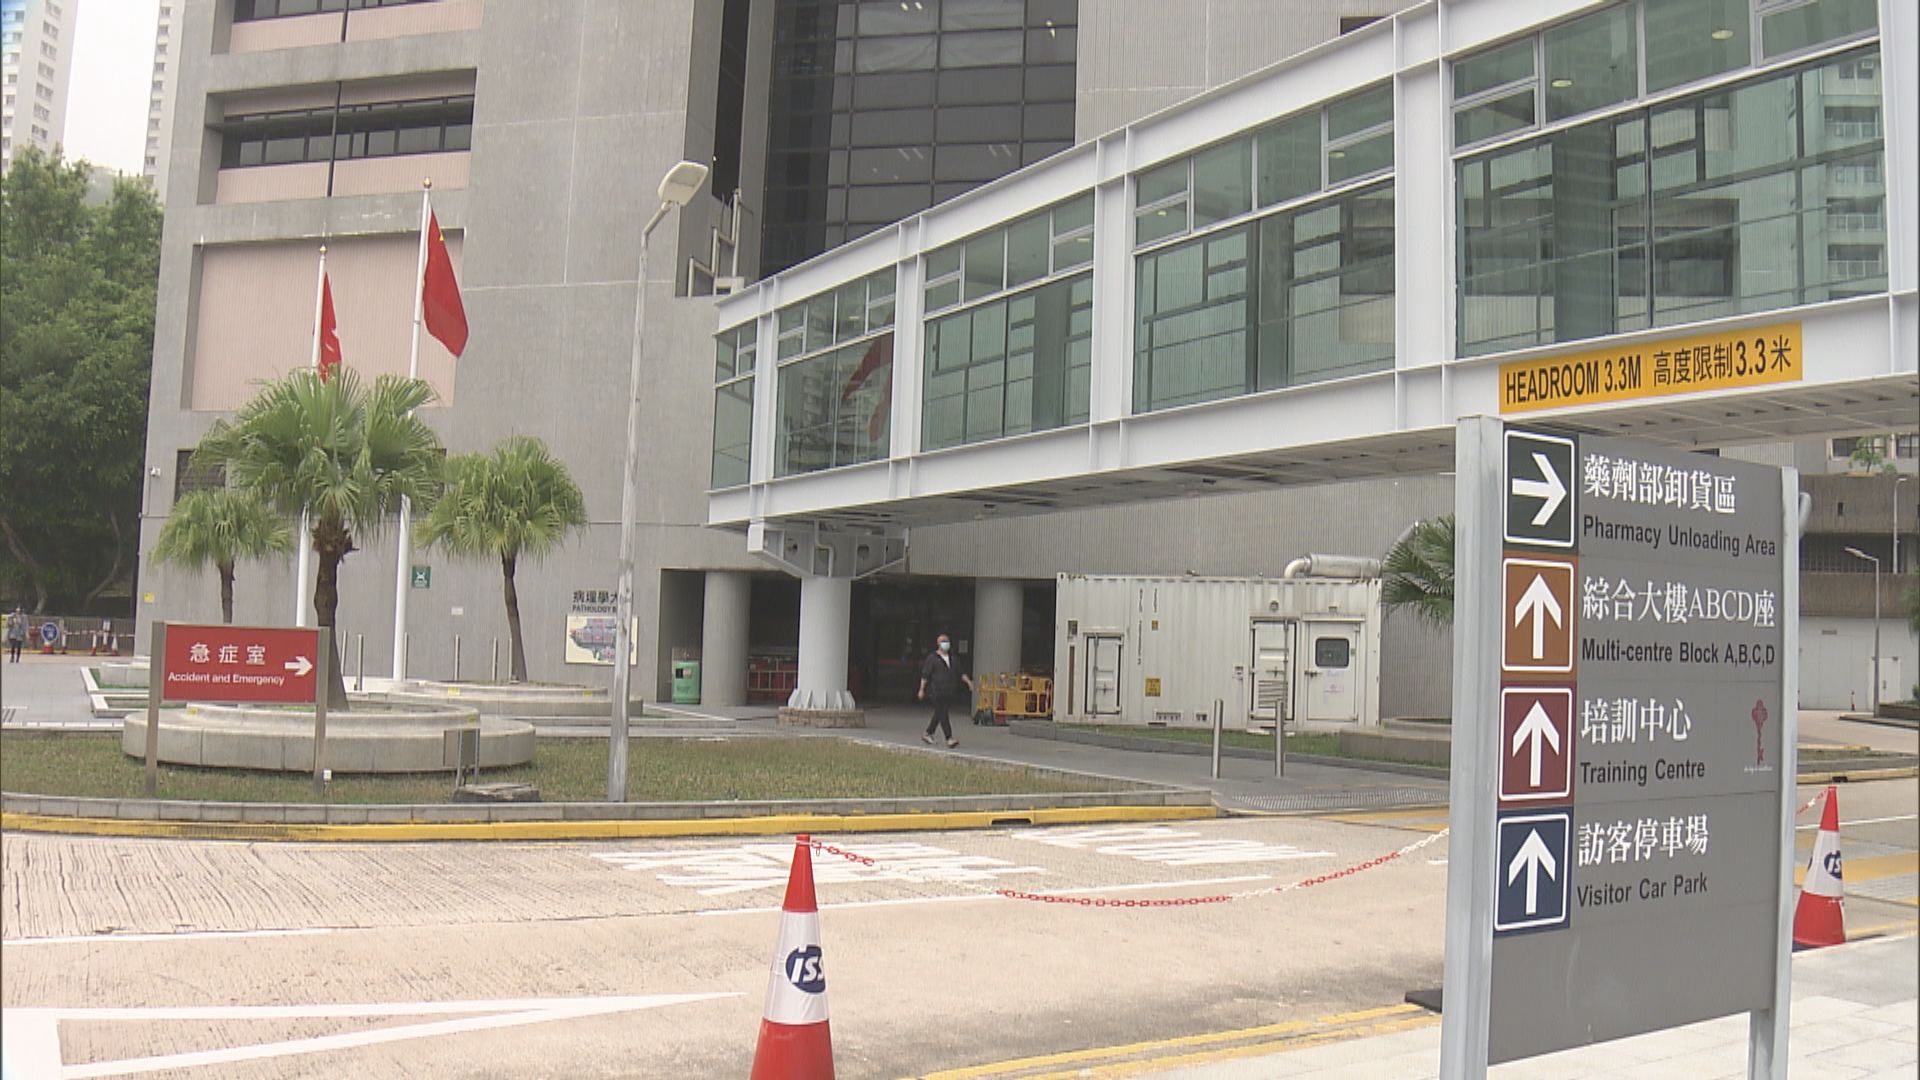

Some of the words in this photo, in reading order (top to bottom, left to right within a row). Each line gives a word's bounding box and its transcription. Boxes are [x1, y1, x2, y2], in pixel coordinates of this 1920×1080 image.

[1506, 360, 1599, 404] HEADROOM
[1605, 354, 1641, 392] 3.3M
[1653, 335, 1792, 387] 高度限制3.3米
[1583, 454, 1737, 514] 藥劑部卸貨區
[1583, 514, 1661, 549] Pharmacy
[1669, 525, 1740, 557] Unloading
[1745, 534, 1776, 556] Area
[1582, 576, 1776, 628] 綜合大樓ABCD座
[190, 642, 266, 665] 急症室
[1582, 638, 1673, 663] Multi-centre
[1680, 641, 1719, 663] Block
[1724, 643, 1775, 668] A,B,C,D
[168, 672, 210, 683] Accident
[212, 674, 231, 684] and
[233, 675, 285, 687] Emergency
[1580, 698, 1691, 745] 培訓中心
[1580, 760, 1648, 787] Training
[1655, 758, 1706, 780] Centre
[1578, 814, 1709, 867] 訪客停車場
[1577, 884, 1632, 908] Visitor
[1639, 878, 1667, 900] Car
[1674, 872, 1708, 896] Park
